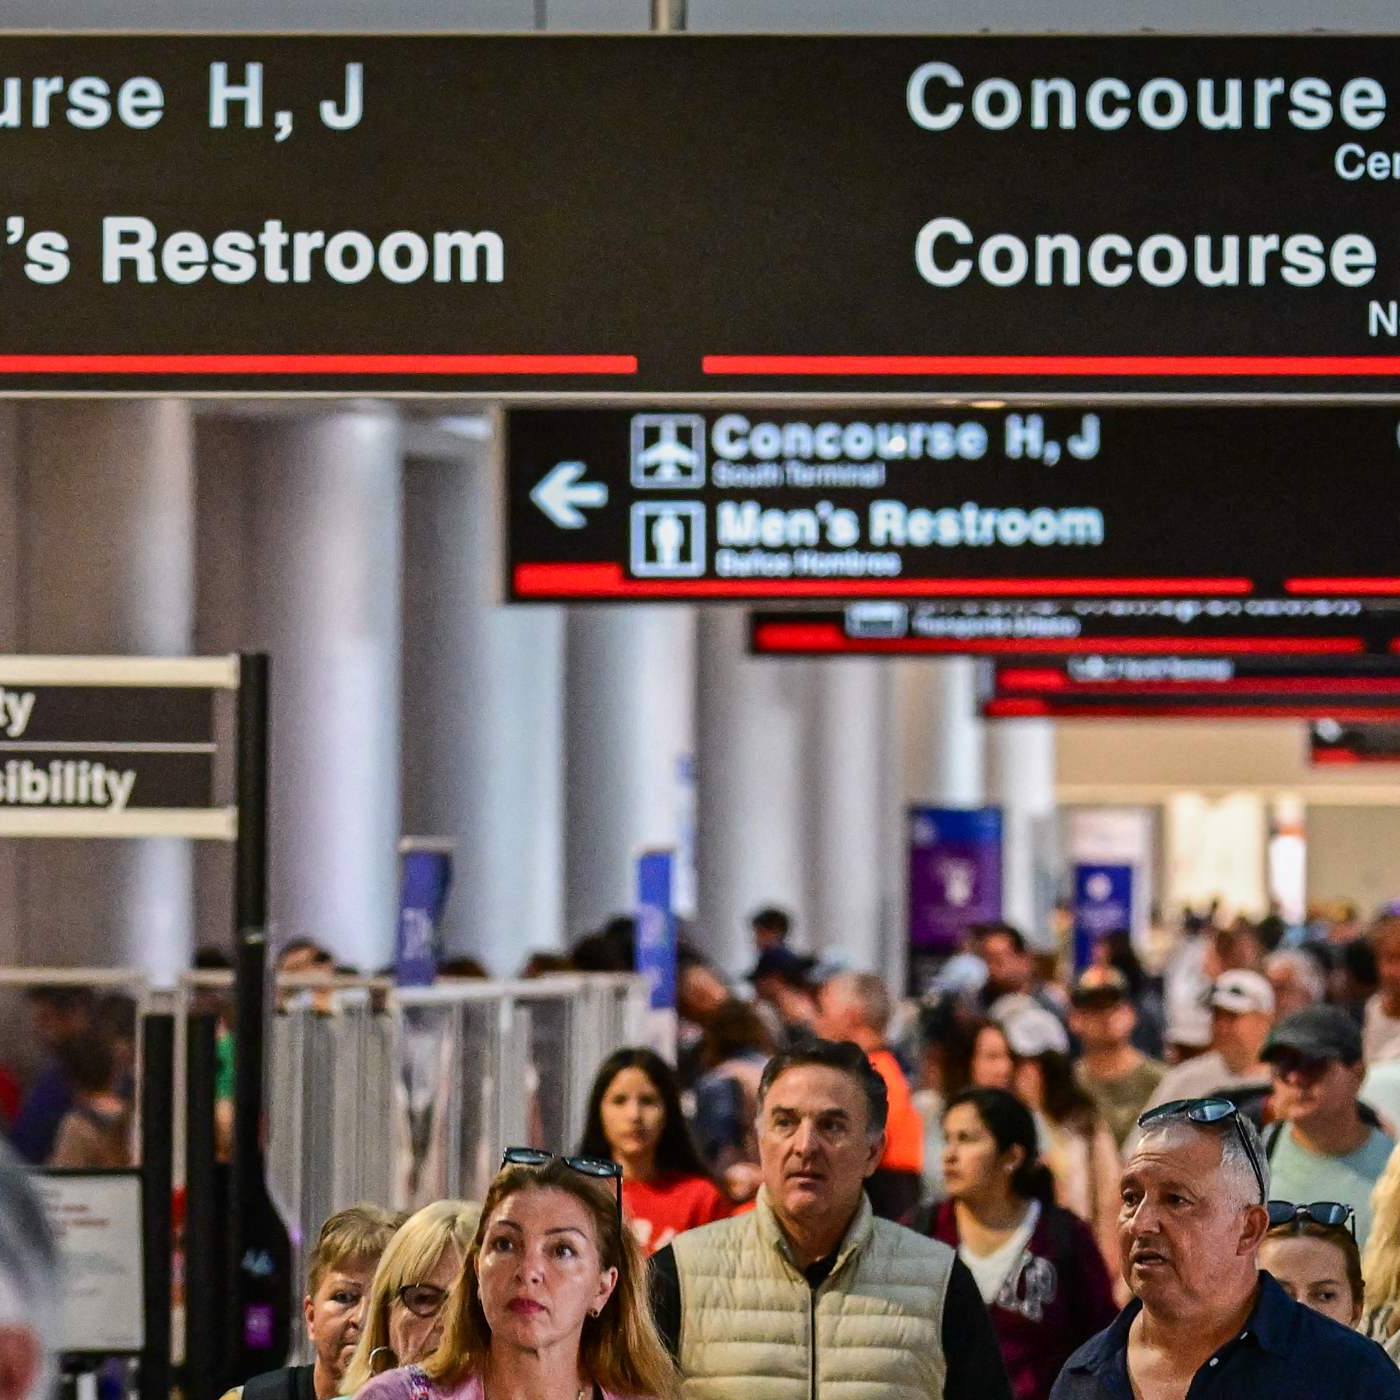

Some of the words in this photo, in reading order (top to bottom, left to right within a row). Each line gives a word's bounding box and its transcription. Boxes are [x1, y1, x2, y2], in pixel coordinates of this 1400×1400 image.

[209, 62, 293, 142] H,
[319, 62, 364, 130] J
[906, 62, 1387, 131] Concourse
[102, 216, 504, 284] Restroom
[914, 217, 1378, 286] Concourse
[711, 413, 988, 460] Concourse
[1004, 413, 1061, 467] H,
[1067, 413, 1100, 460] J
[716, 501, 860, 547] Men's
[869, 500, 1103, 547] Restroom
